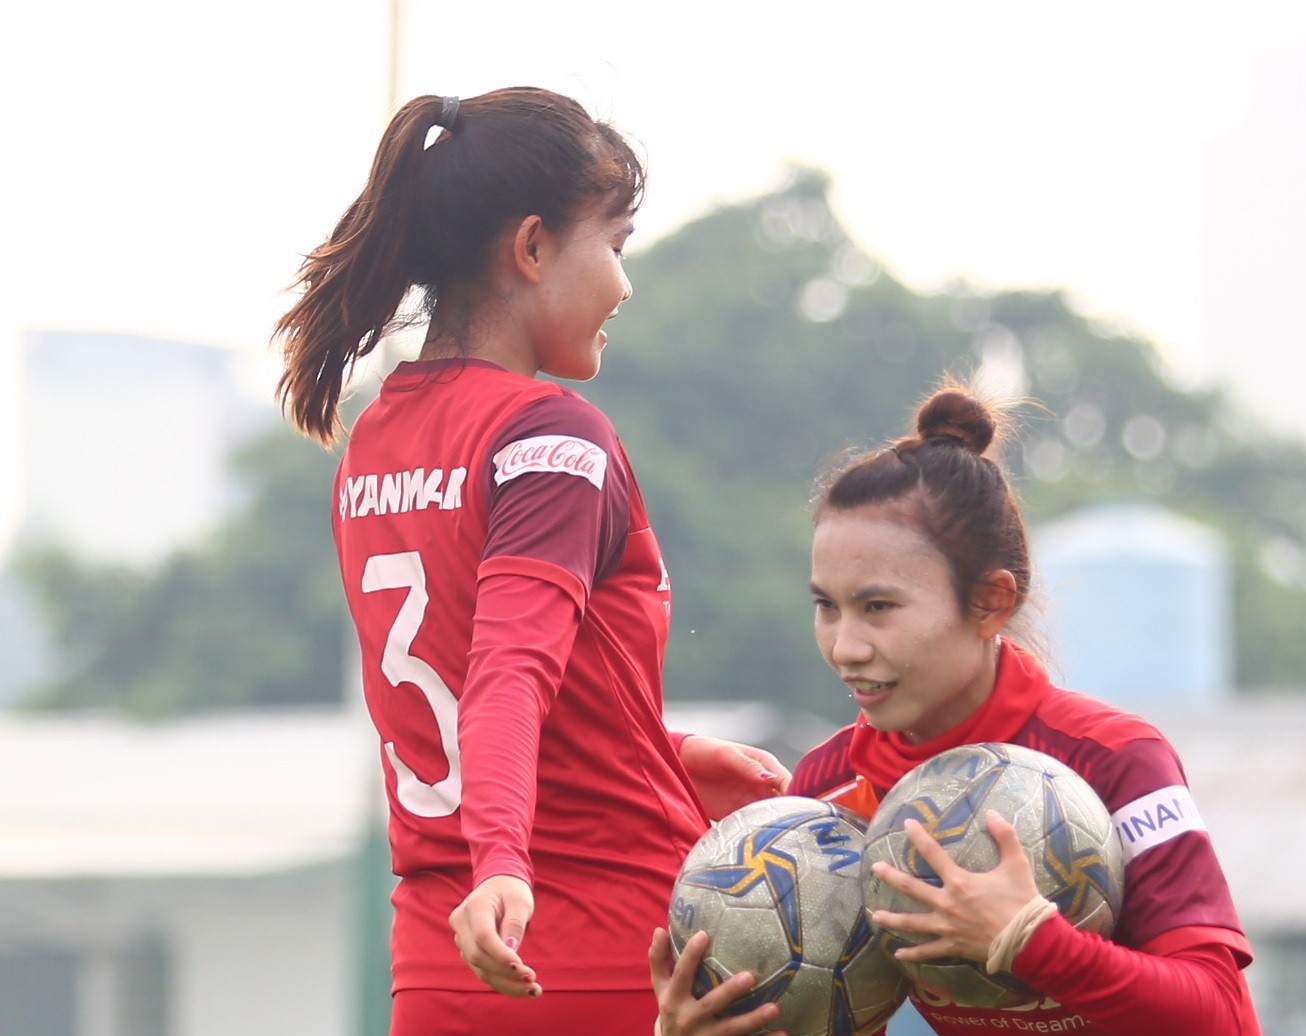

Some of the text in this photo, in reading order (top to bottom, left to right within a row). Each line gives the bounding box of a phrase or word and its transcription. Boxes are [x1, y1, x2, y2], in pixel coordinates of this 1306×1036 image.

[361, 551, 461, 818] 3
[990, 1016, 1010, 1029] of
[1013, 1014, 1091, 1033] Dream
